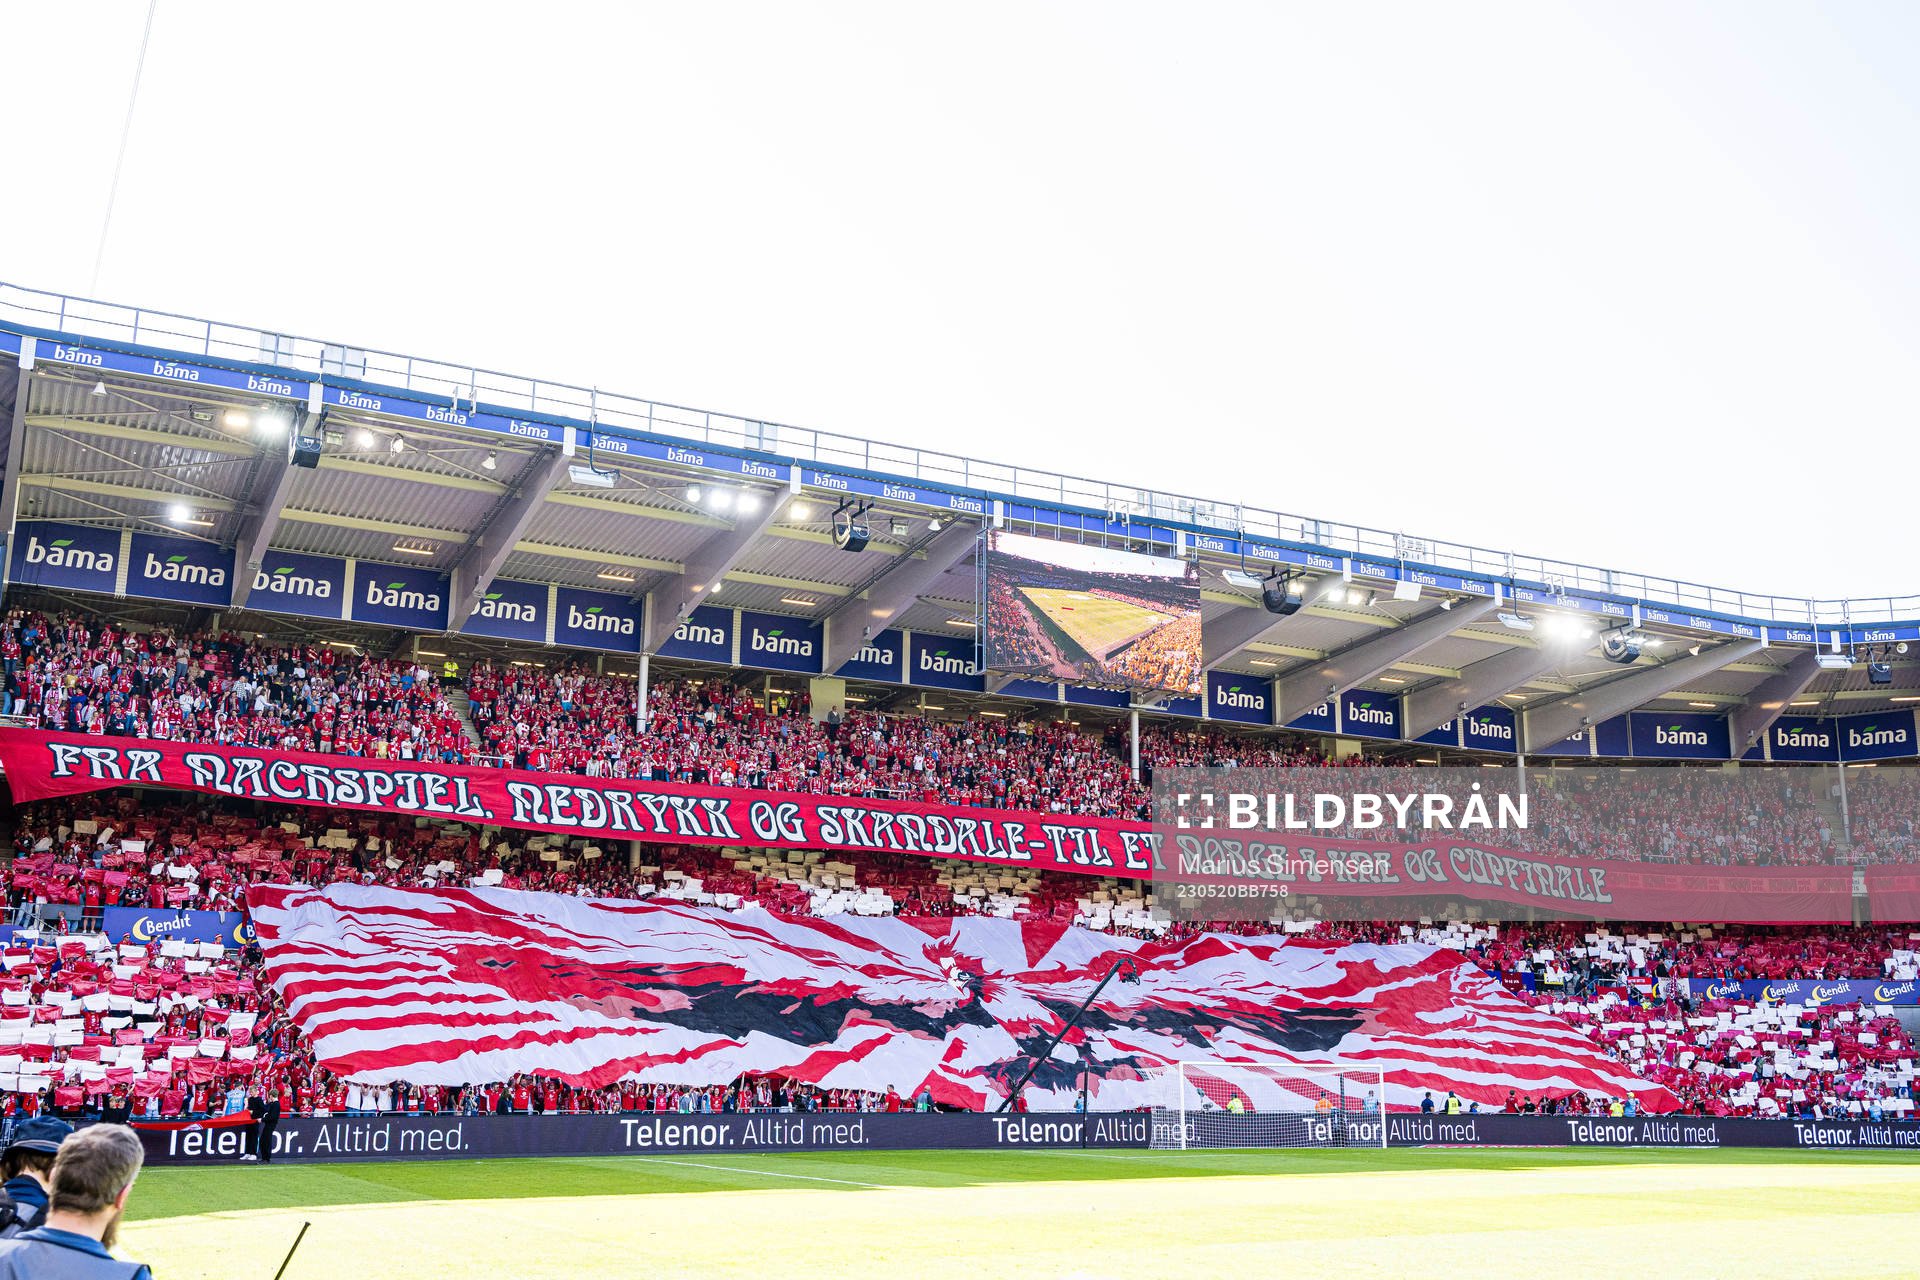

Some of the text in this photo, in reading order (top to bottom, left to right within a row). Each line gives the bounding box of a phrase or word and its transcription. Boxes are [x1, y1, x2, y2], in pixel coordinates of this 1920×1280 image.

[26, 536, 113, 572] bama
[144, 552, 225, 586] bama
[367, 580, 440, 611] bama
[567, 606, 635, 635] bama
[674, 622, 725, 645] ama
[751, 629, 813, 656] bama
[850, 646, 893, 665] ma
[1217, 685, 1265, 710] bama
[1349, 702, 1393, 725] bama
[1470, 716, 1511, 739] bama
[1656, 725, 1708, 745] bama
[1777, 728, 1830, 748] bama
[1849, 728, 1907, 747] bama
[48, 743, 163, 781] FRA
[507, 781, 740, 840] NEDRYKK
[750, 801, 806, 842] OG
[1120, 831, 1167, 870] ET
[1404, 849, 1448, 882] OG
[1450, 847, 1612, 903] CUPFINALE
[146, 914, 192, 935] Bendit
[1769, 982, 1800, 997] Bendit
[1821, 982, 1851, 997] Bendit
[1882, 982, 1915, 998] Bendit
[313, 1123, 390, 1153] Alltid
[400, 1122, 469, 1151] med.
[620, 1119, 869, 1147] Telenor. Alltid med.
[1094, 1118, 1146, 1142] Alltid
[1390, 1118, 1433, 1141] Alltid
[1439, 1119, 1480, 1141] med.
[1567, 1120, 1720, 1143] Telenor. Alltid med.
[1794, 1124, 1856, 1144] Telenor.
[1859, 1126, 1892, 1145] Alltid
